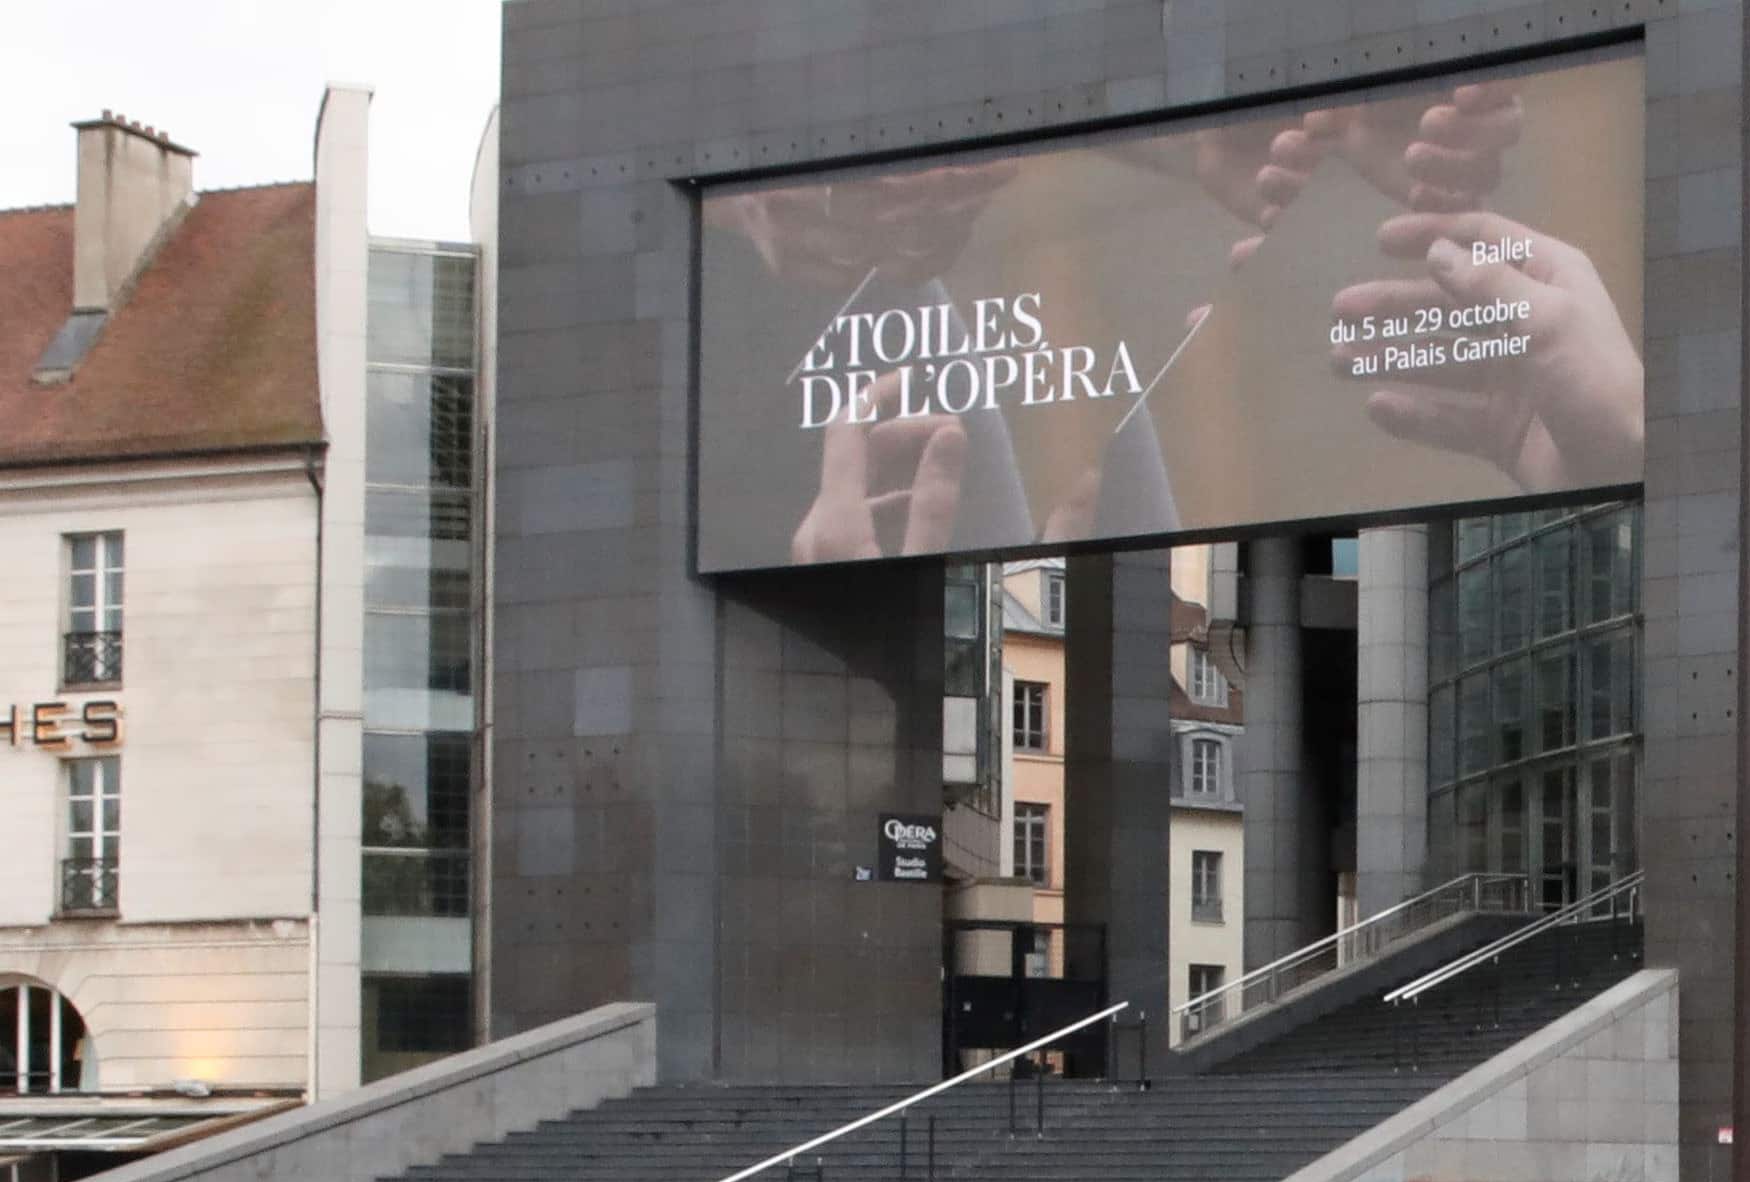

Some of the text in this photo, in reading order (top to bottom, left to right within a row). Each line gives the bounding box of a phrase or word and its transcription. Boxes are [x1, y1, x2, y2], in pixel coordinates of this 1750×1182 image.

[1472, 237, 1533, 266] Ballet
[1330, 298, 1530, 344] du 5 au 29 octobre
[1352, 334, 1531, 375] au Palais Garnier
[801, 370, 877, 429] DE
